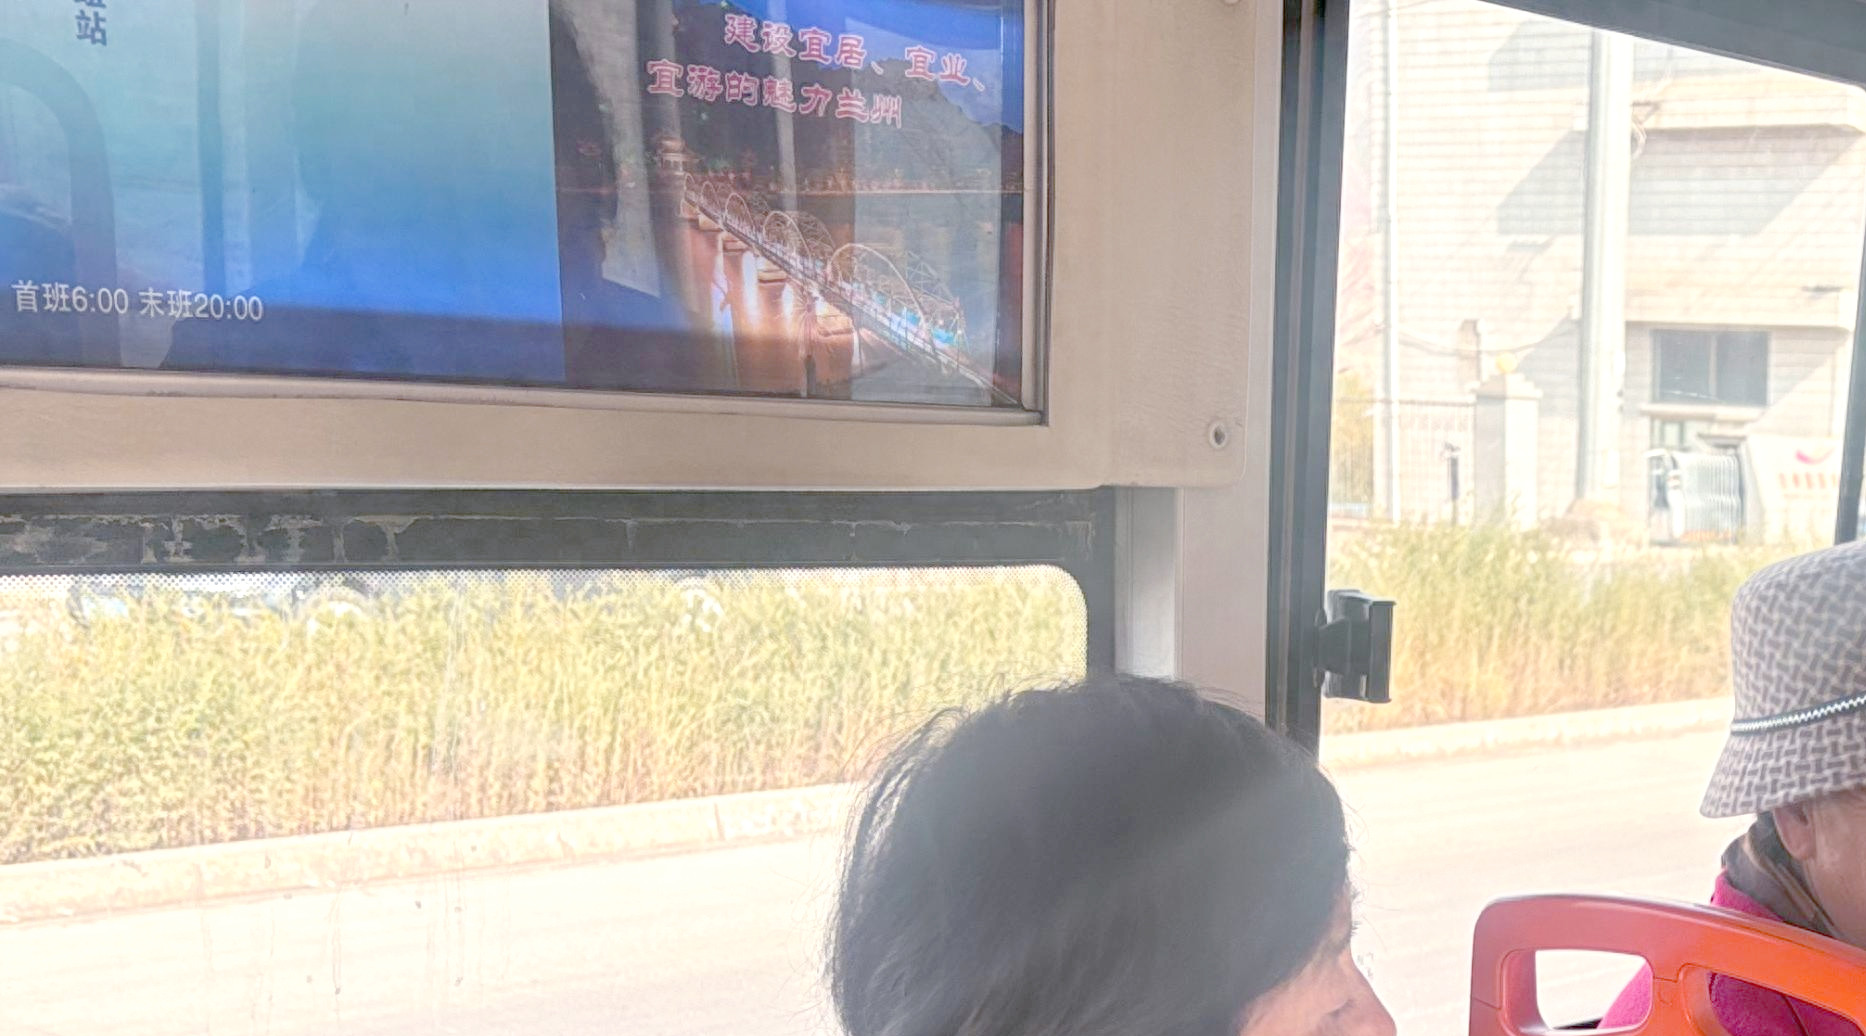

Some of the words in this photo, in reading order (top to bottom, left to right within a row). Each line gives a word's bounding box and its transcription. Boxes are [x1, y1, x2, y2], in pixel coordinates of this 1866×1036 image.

[74, 0, 107, 46] 站
[724, 13, 985, 92] 建设宜居、宜业、
[646, 58, 902, 129] 宜游的魅力兰州
[12, 279, 129, 314] 首班6:00
[138, 287, 264, 321] 末班20:00
